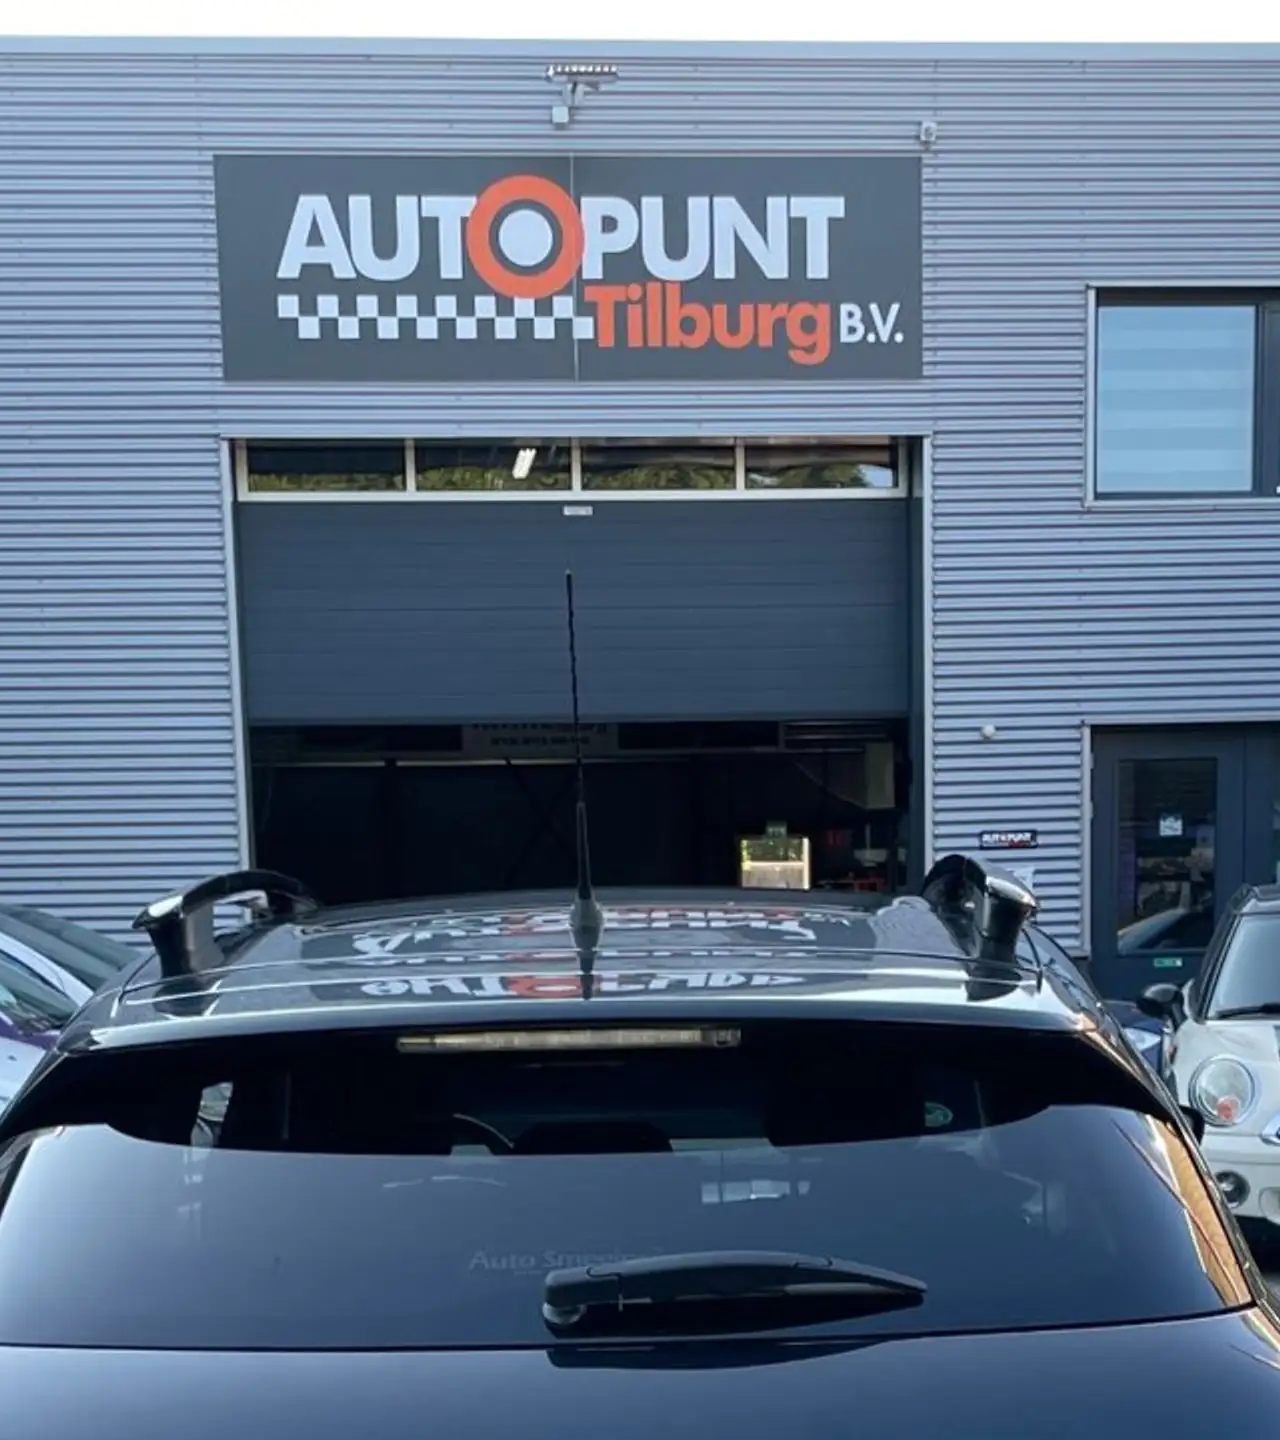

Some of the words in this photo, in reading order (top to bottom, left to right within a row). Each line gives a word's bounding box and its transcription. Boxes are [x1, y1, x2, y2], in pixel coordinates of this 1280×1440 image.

[276, 175, 845, 299] AUTOPUNT
[584, 282, 831, 365] Tilburg
[839, 303, 904, 343] B.V.
